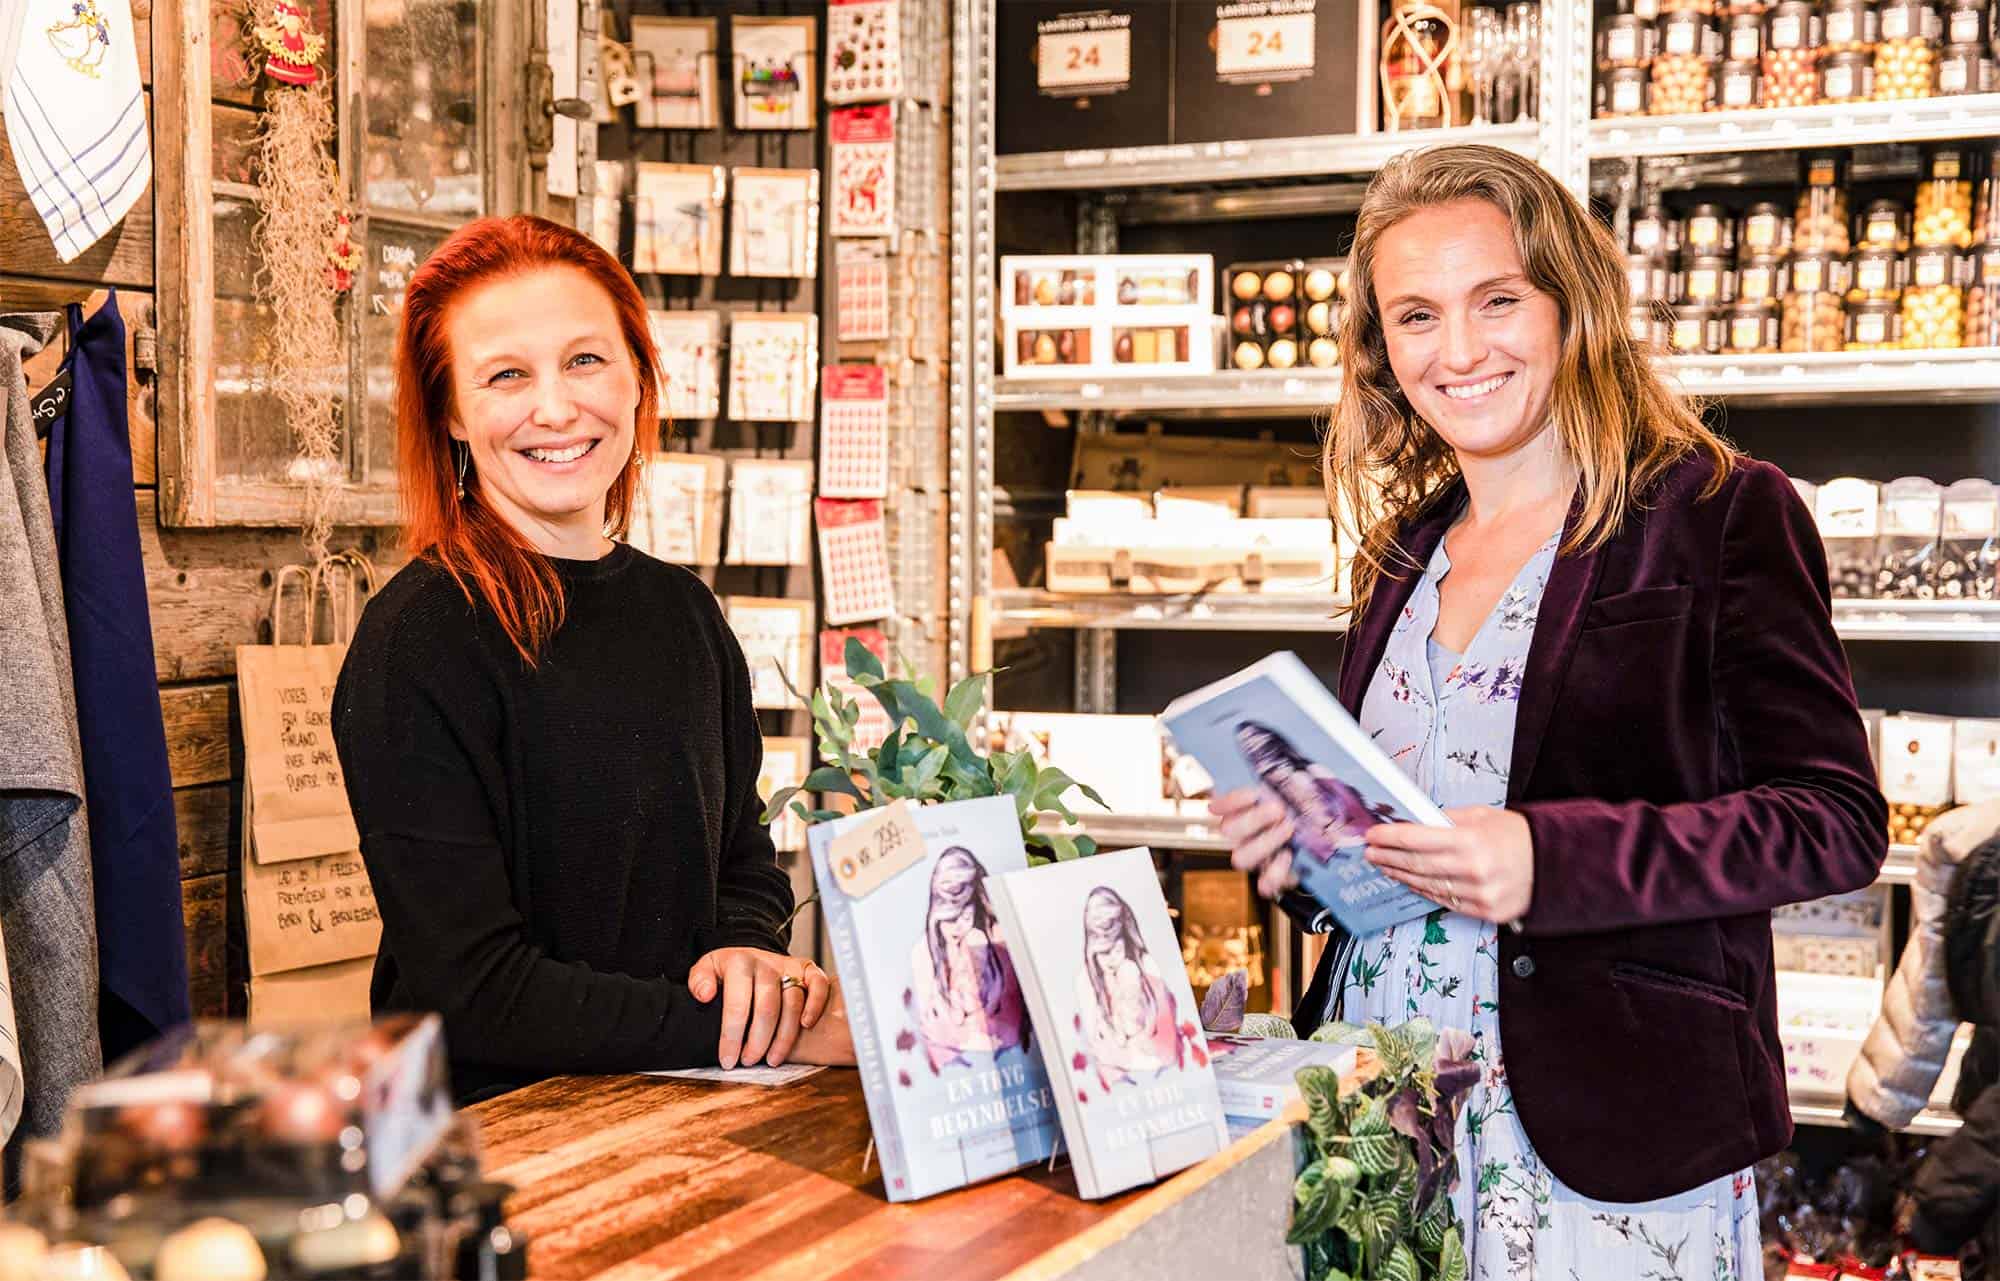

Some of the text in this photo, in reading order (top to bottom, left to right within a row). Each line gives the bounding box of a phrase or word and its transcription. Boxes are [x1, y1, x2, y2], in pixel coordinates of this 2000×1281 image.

[1066, 46, 1100, 70] 24
[1247, 31, 1284, 55] 24
[945, 1063, 1026, 1103] EN TRYG
[929, 1087, 1052, 1140] BEGYNDELSE
